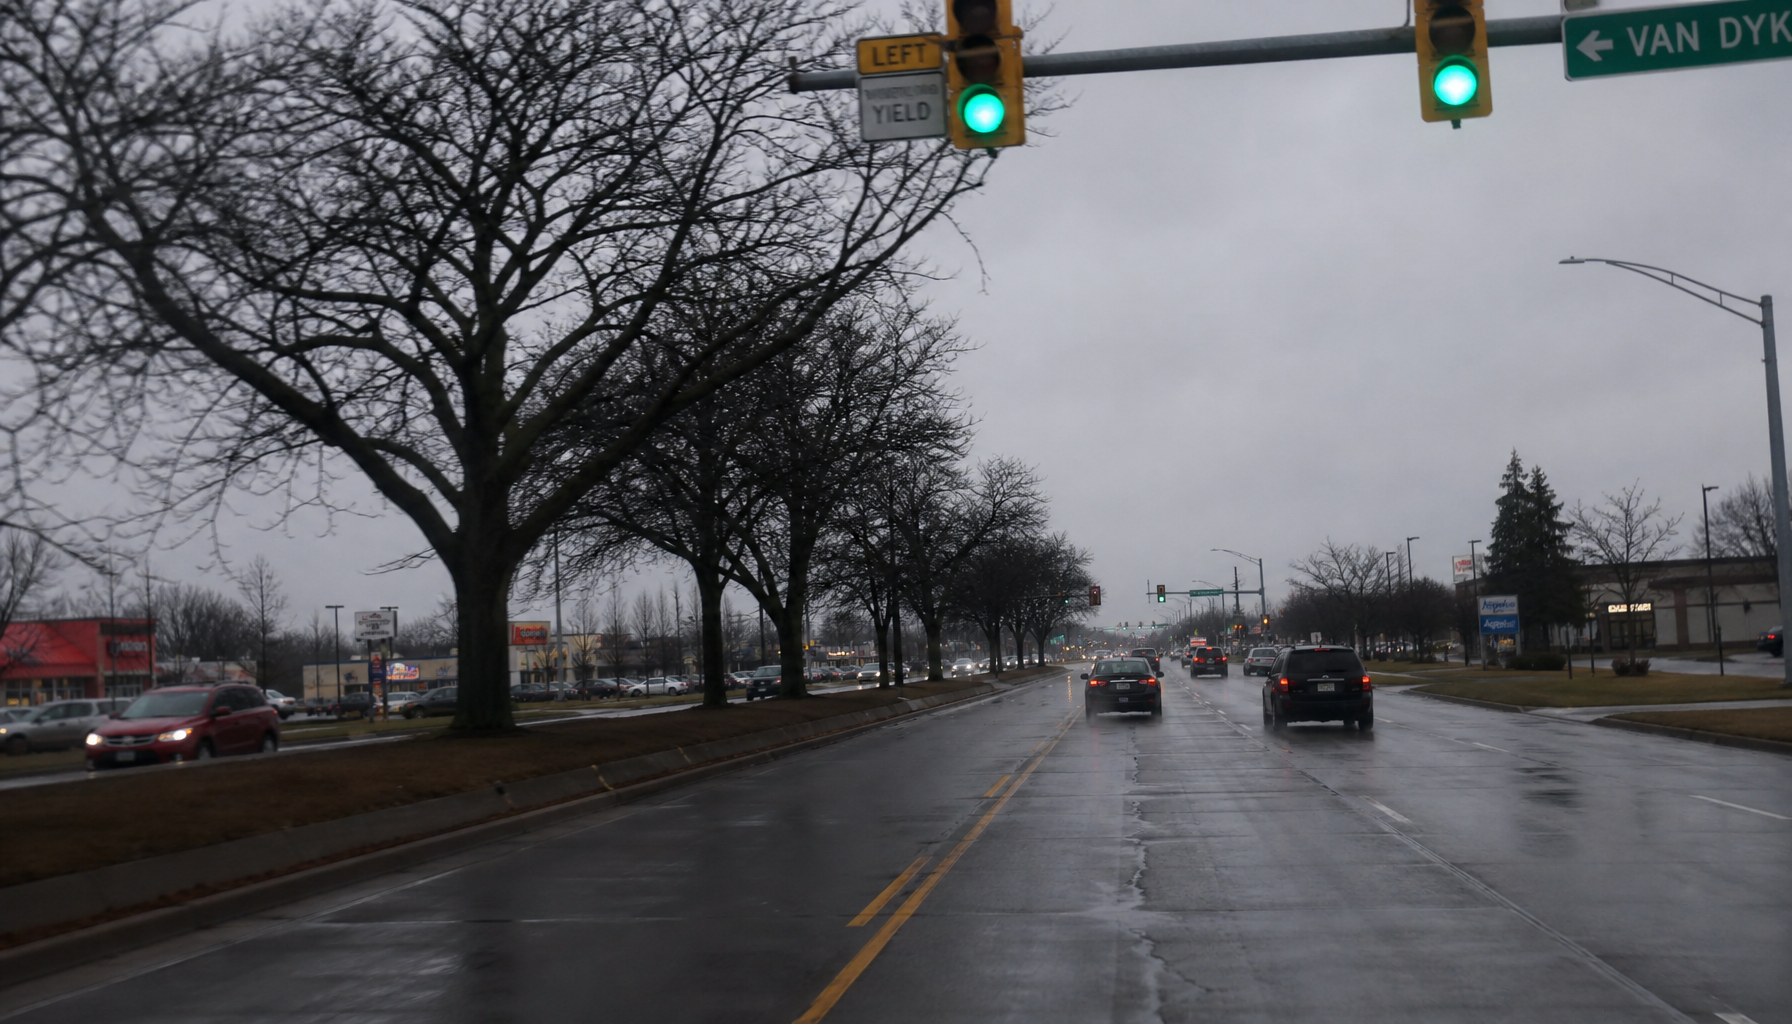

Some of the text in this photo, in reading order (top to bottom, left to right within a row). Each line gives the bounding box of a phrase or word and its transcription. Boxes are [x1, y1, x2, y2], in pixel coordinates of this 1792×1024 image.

[1626, 20, 1700, 57] VAN
[871, 43, 927, 67] LEFT
[872, 101, 931, 124] YIELD
